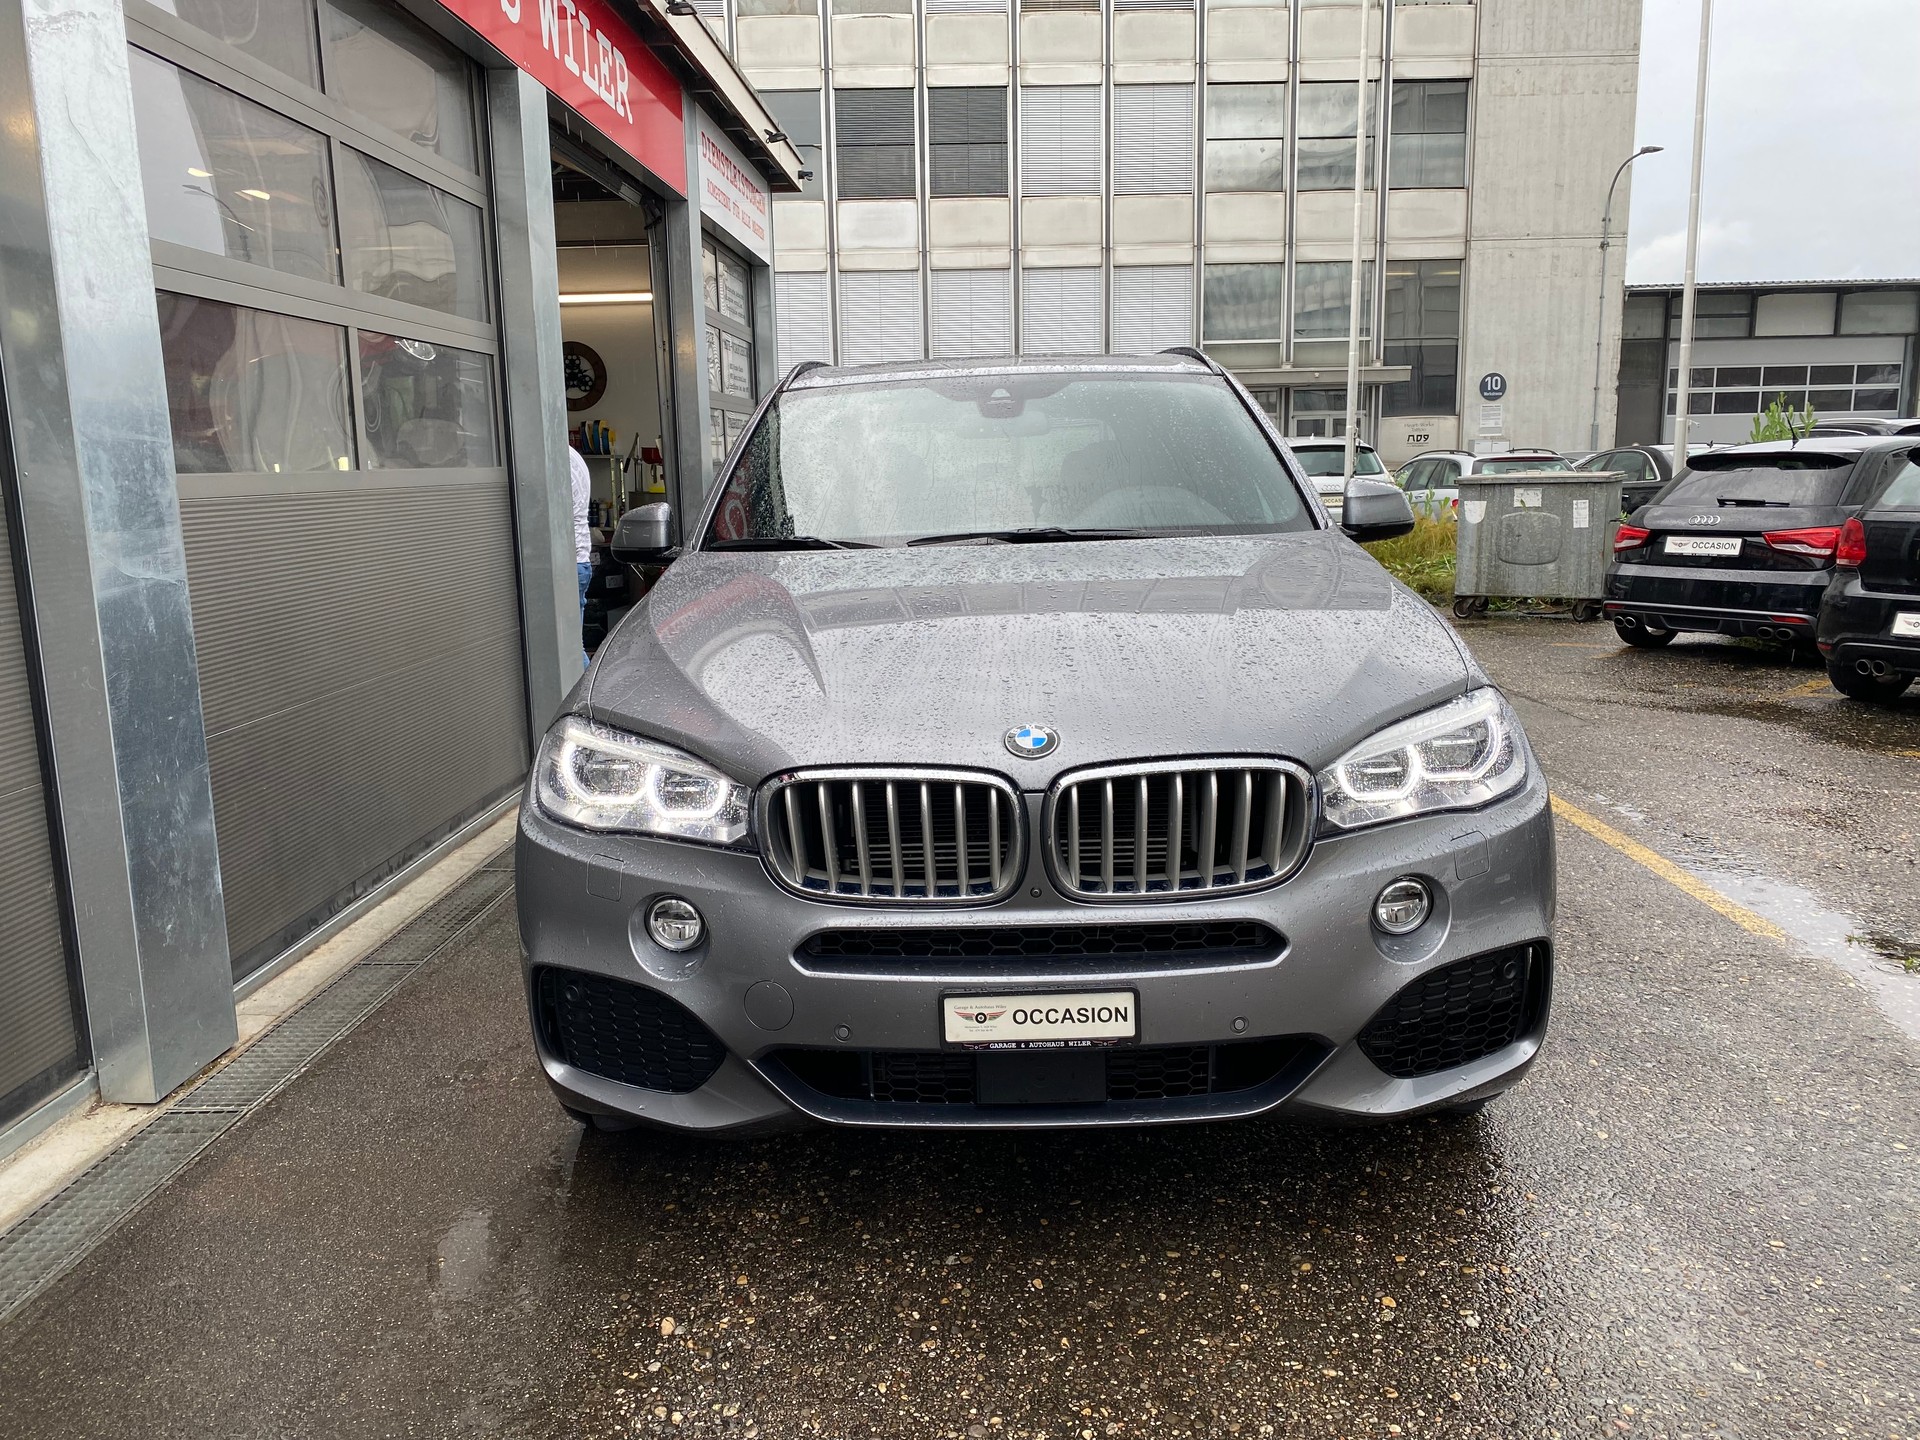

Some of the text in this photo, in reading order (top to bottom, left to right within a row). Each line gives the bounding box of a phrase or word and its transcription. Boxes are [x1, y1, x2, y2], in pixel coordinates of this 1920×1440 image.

[538, 0, 633, 125] WILER
[1485, 376, 1501, 391] 10
[1692, 541, 1737, 550] OCCASION
[1012, 1006, 1128, 1025] OCCASION
